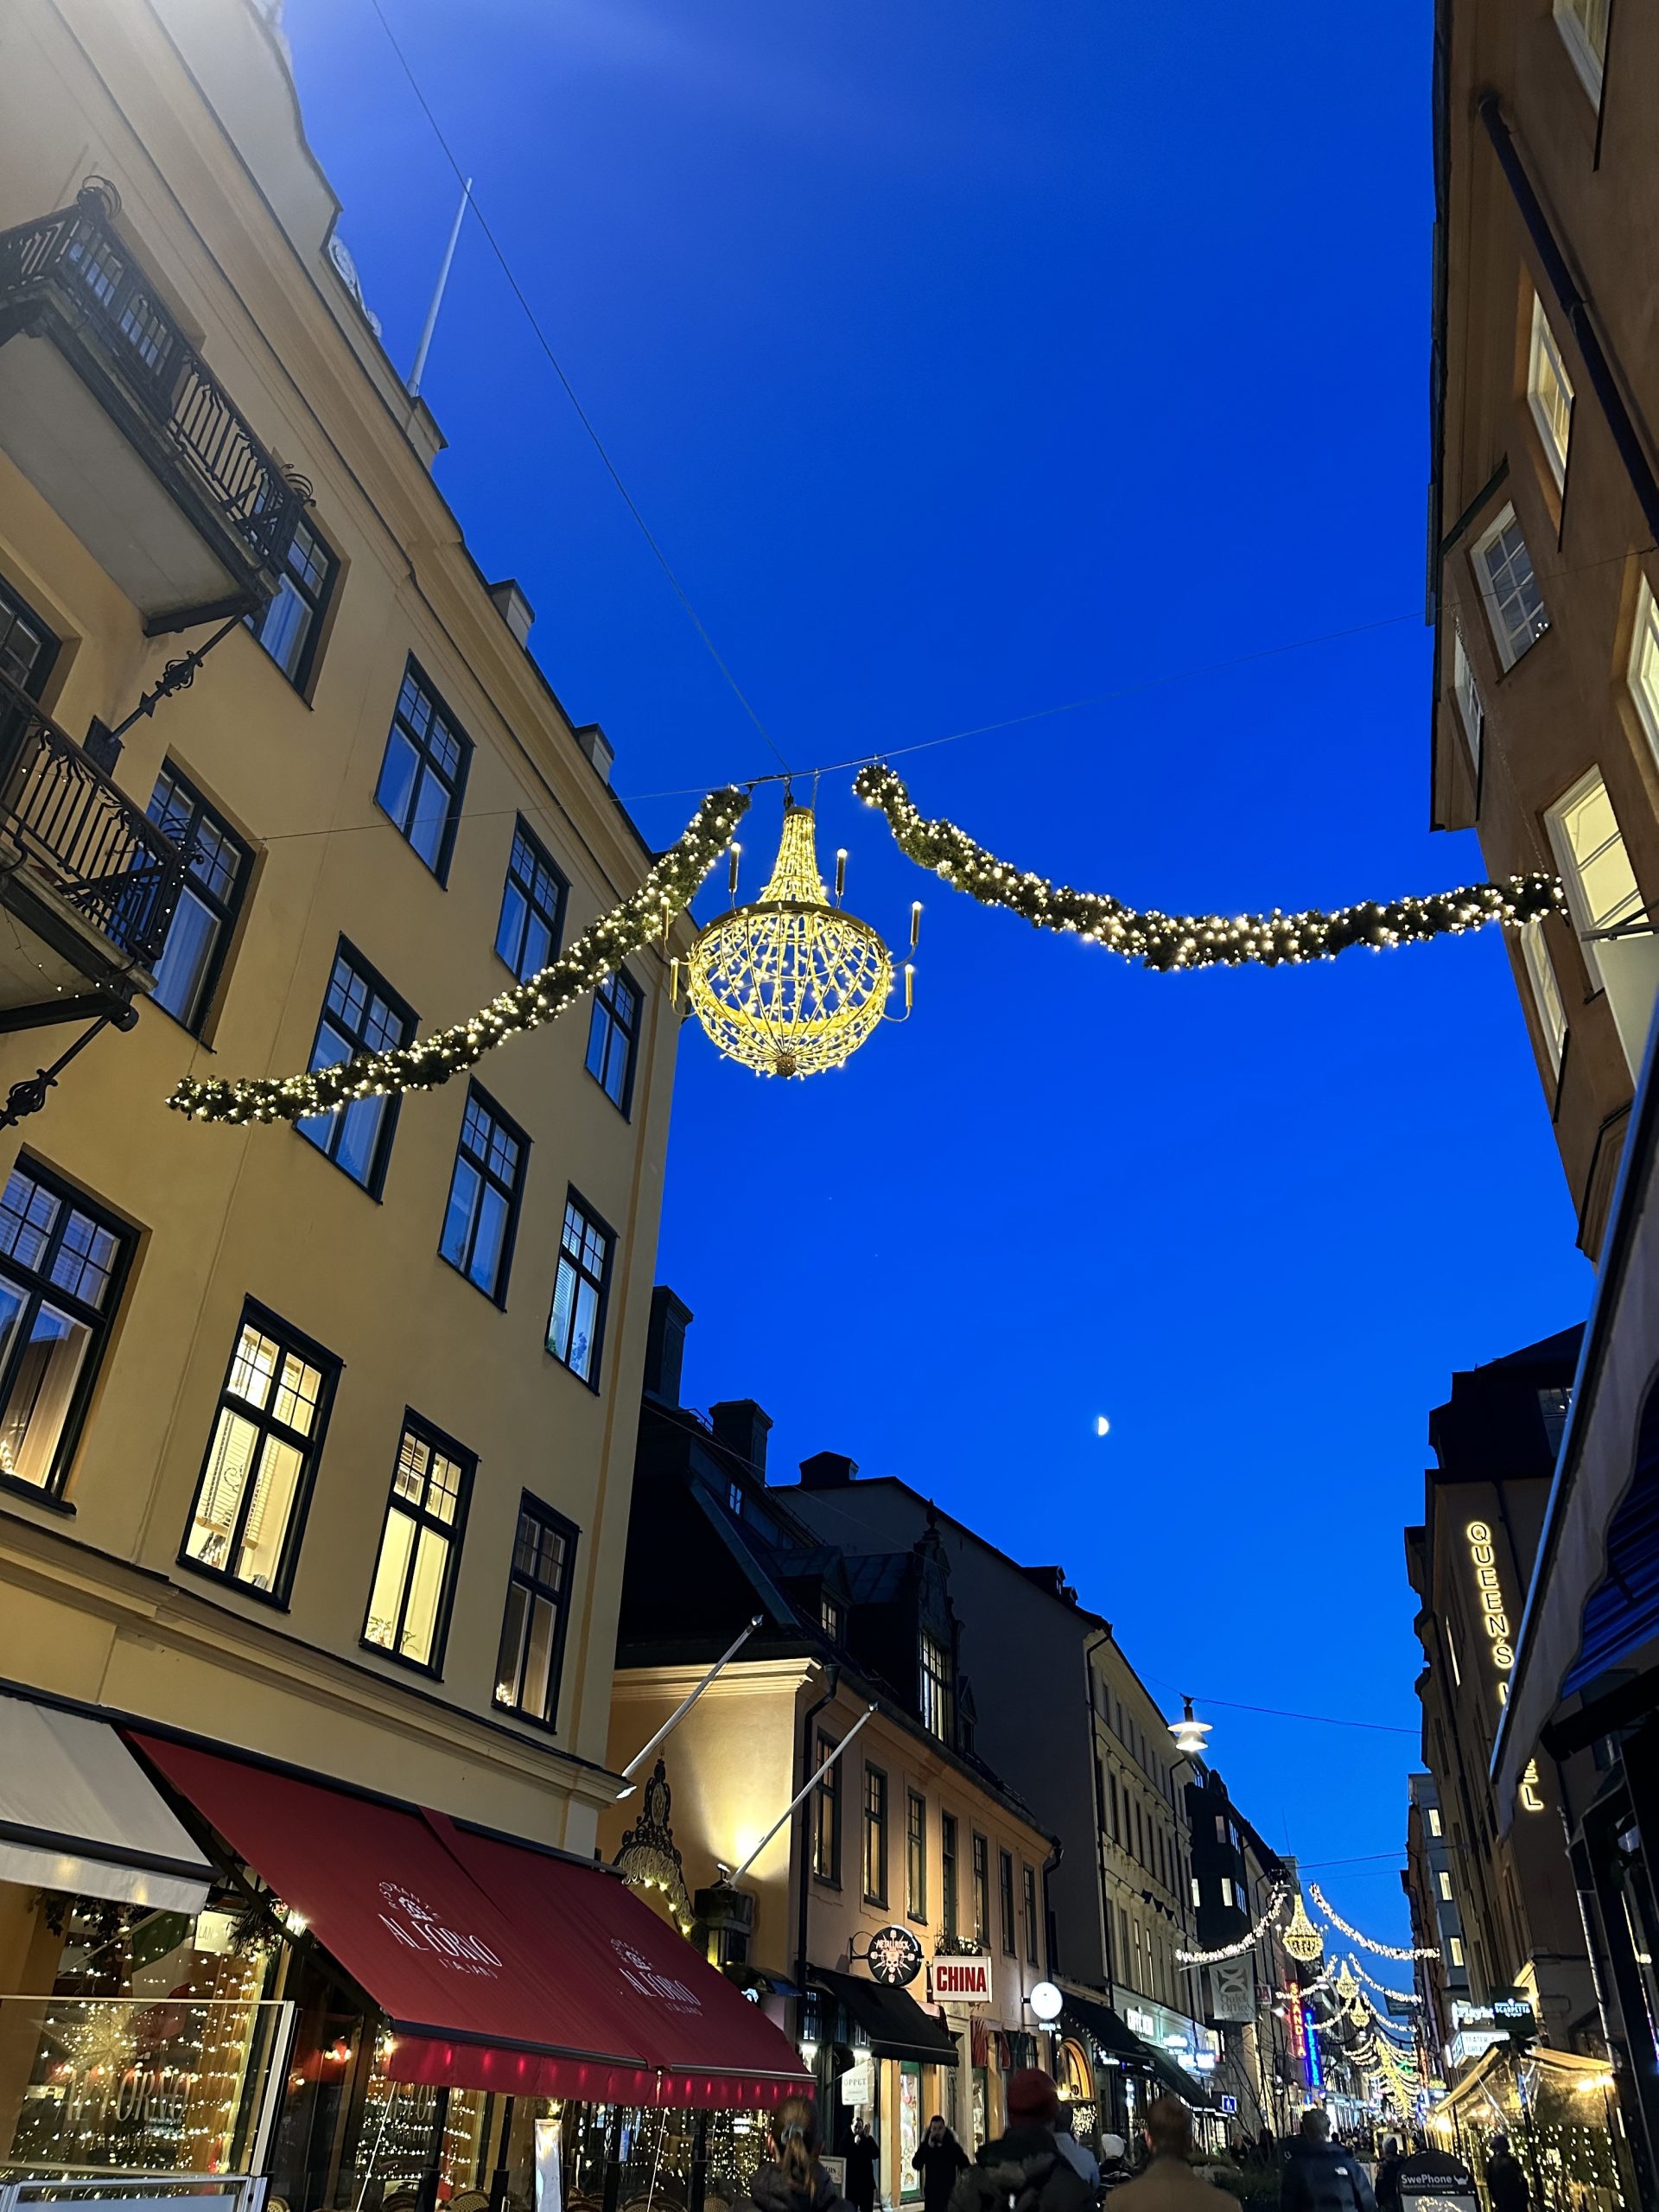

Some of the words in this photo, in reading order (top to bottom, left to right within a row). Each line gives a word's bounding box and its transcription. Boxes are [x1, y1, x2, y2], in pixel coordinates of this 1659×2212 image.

[1468, 1522, 1513, 1667] QUEEN'S
[378, 1913, 429, 1950] AL
[410, 1921, 502, 1967] FORNO
[619, 1967, 657, 1997] AL
[937, 1966, 987, 1992] CHINA
[1220, 1993, 1249, 2003] Quick
[1288, 1982, 1306, 2057] SKANDIA
[1401, 2173, 1452, 2184] SwePhone
